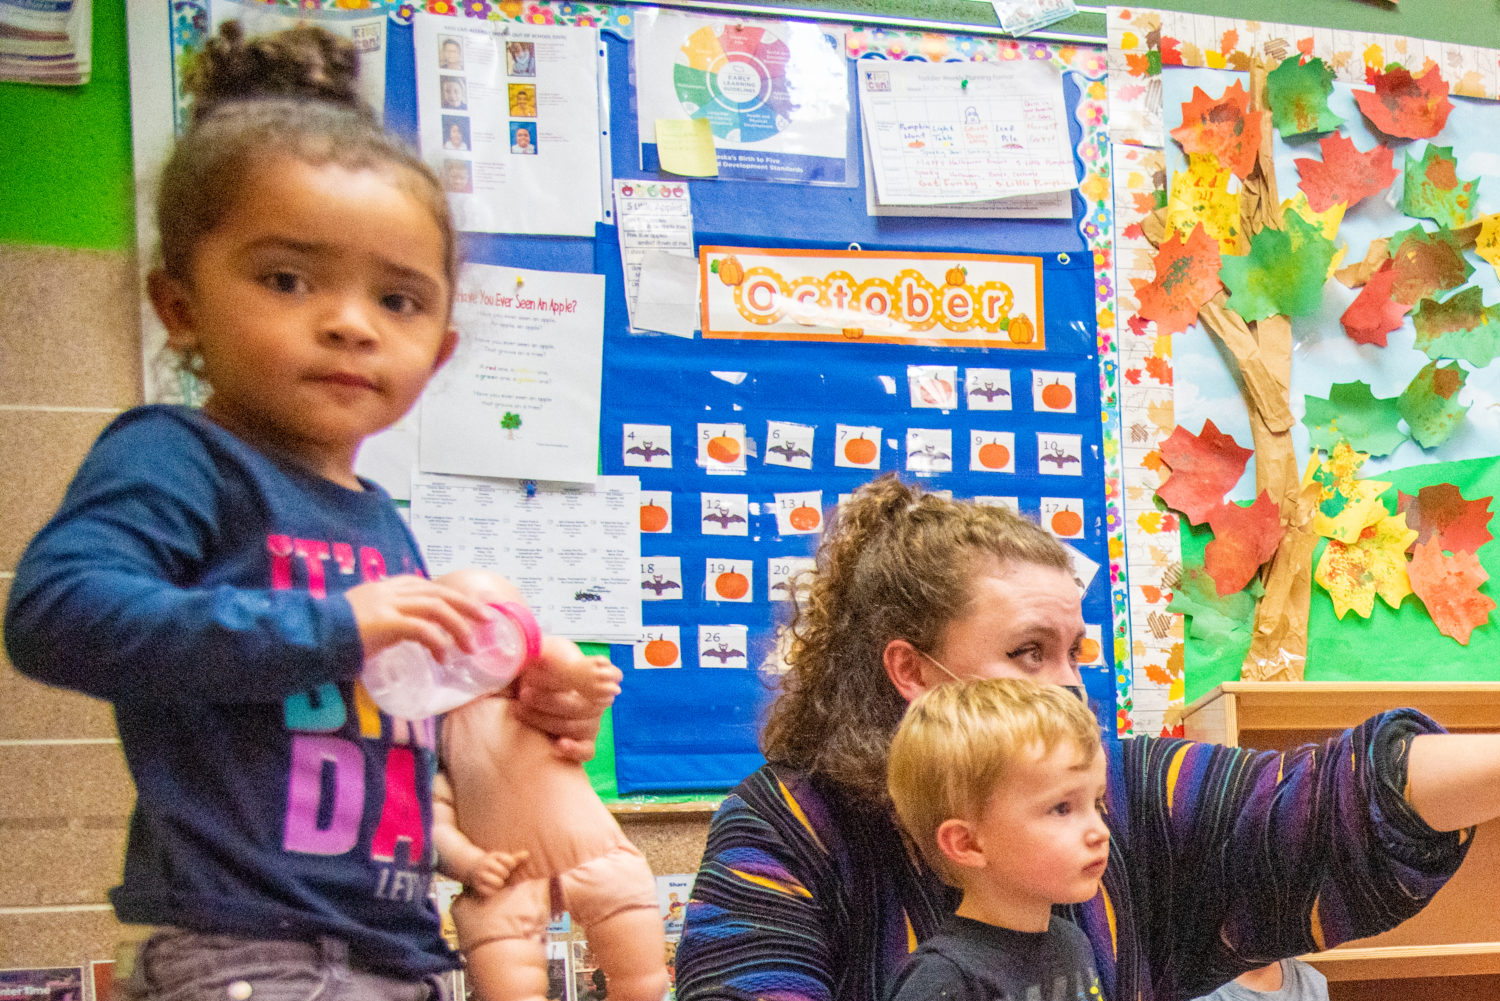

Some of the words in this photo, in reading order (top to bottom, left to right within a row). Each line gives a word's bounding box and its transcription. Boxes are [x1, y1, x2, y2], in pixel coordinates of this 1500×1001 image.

[722, 162, 768, 171] Development
[770, 164, 803, 172] Standards
[480, 289, 495, 304] You
[496, 293, 513, 308] Ever
[515, 294, 537, 311] Seen
[538, 297, 548, 312] An
[549, 298, 577, 316] Apple?
[747, 281, 1002, 320] October
[972, 376, 979, 385] 2
[1037, 377, 1043, 387] 3
[628, 431, 635, 440] 4
[703, 430, 711, 440] 5
[772, 429, 780, 439] 6
[840, 431, 848, 440] 7
[975, 437, 982, 446] 9
[1044, 441, 1058, 451] 10
[706, 500, 720, 509] 12
[781, 499, 796, 509] 13
[1045, 504, 1059, 513] 17
[640, 564, 654, 574] 18
[710, 564, 725, 574] 19
[773, 566, 790, 575] 20
[705, 632, 721, 642] 26
[283, 734, 438, 864] DA
[24, 986, 51, 995] Time
